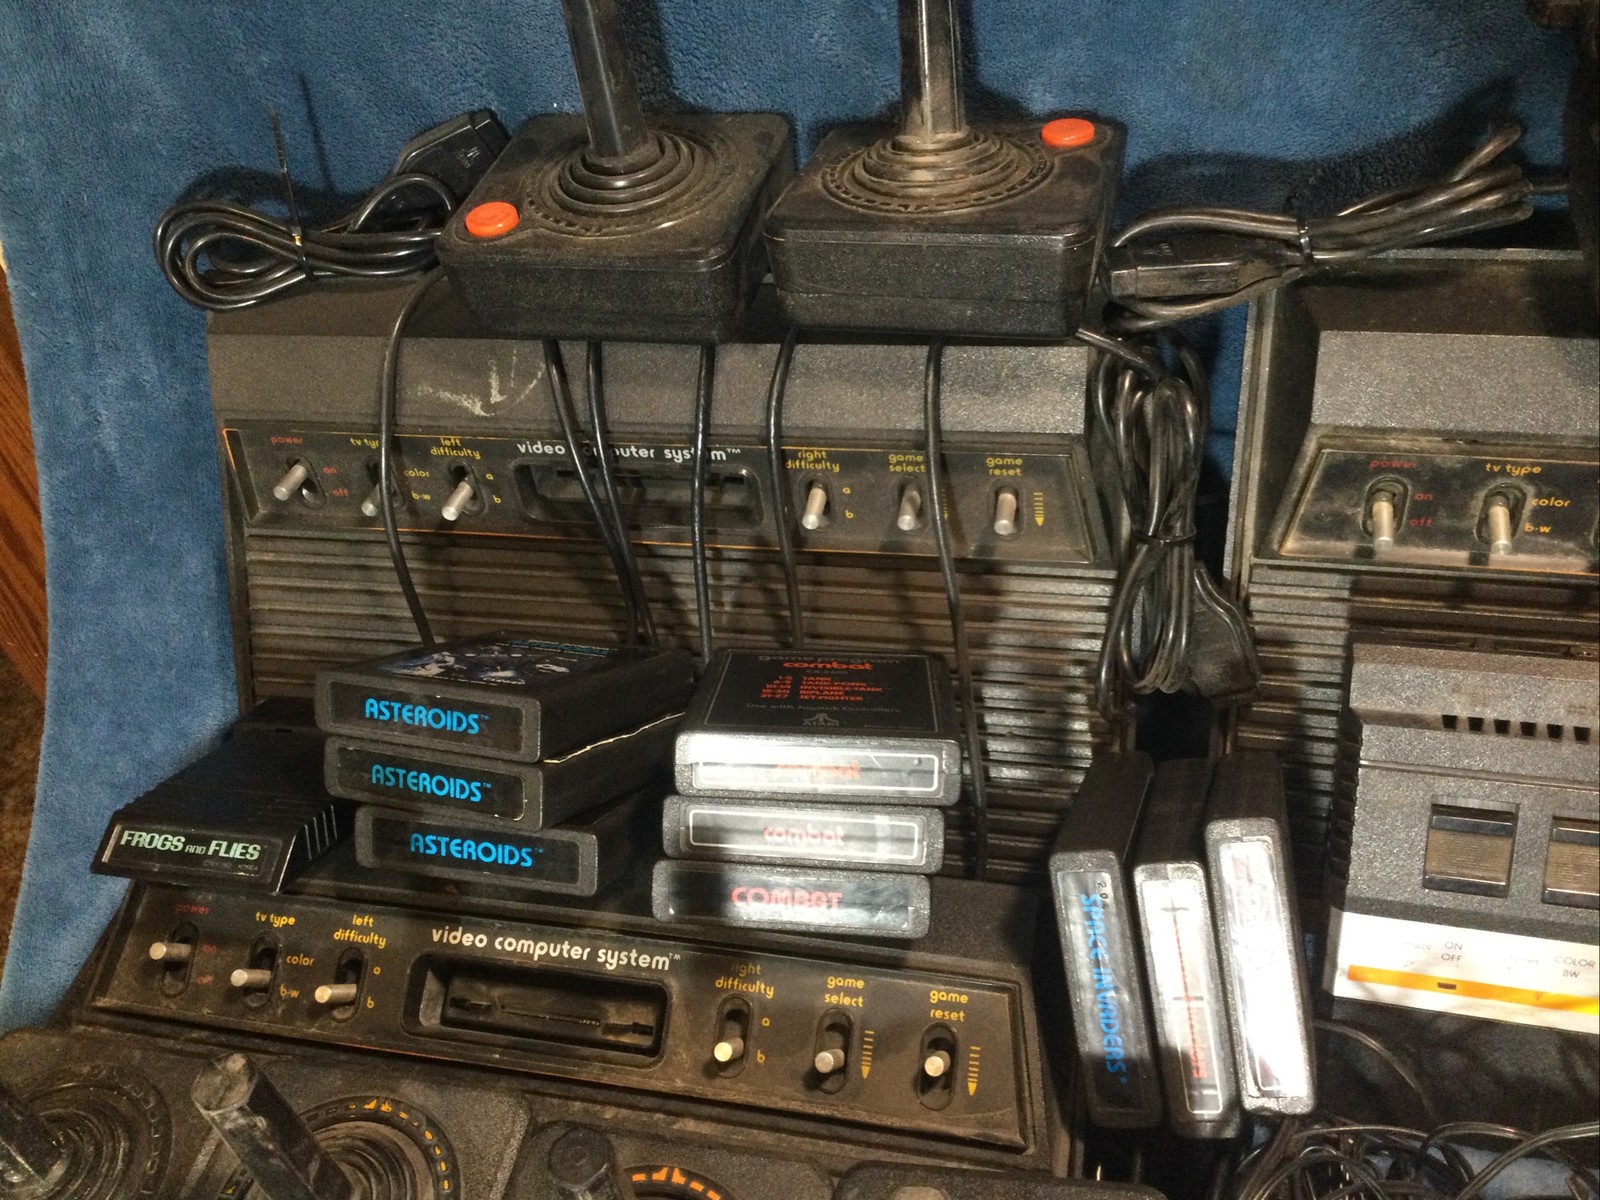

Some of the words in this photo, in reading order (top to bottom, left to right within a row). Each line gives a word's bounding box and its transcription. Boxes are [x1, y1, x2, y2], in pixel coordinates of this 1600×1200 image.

[350, 437, 361, 446] tv
[364, 438, 379, 450] ty
[440, 437, 461, 447] left
[517, 441, 566, 456] video
[430, 447, 481, 459] difficulty
[798, 450, 827, 461] right
[888, 453, 924, 465] game
[785, 459, 840, 473] difficulty
[888, 463, 926, 473] select
[986, 456, 1023, 468] game
[404, 468, 430, 478] color
[988, 466, 1021, 477] reset
[1485, 463, 1501, 473] tv
[1506, 464, 1542, 476] type
[486, 473, 494, 481] a
[842, 487, 851, 495] a
[494, 494, 502, 503] b
[1531, 497, 1571, 508] color
[845, 509, 854, 519] b
[783, 661, 874, 671] combat
[763, 824, 845, 846] combat
[120, 830, 185, 852] FROGS
[207, 840, 261, 861] FLIES
[731, 886, 843, 910] COMBAT
[256, 911, 267, 923] tv
[270, 913, 296, 928] type
[352, 915, 374, 928] left
[1080, 893, 1109, 960] SPACE
[333, 929, 386, 949] difficulty
[432, 927, 488, 948] video
[495, 936, 591, 961] computer
[1444, 941, 1463, 951] ON
[286, 953, 314, 966] color
[1441, 953, 1463, 962] OFF
[1554, 955, 1596, 968] COLOR
[373, 966, 381, 975] a
[715, 977, 774, 999] difficulty
[827, 976, 864, 989] game
[367, 997, 374, 1009] b
[824, 992, 864, 1008] select
[930, 990, 969, 1004] game
[930, 1008, 965, 1022] reset
[762, 1017, 770, 1027] a
[757, 1050, 766, 1063] b
